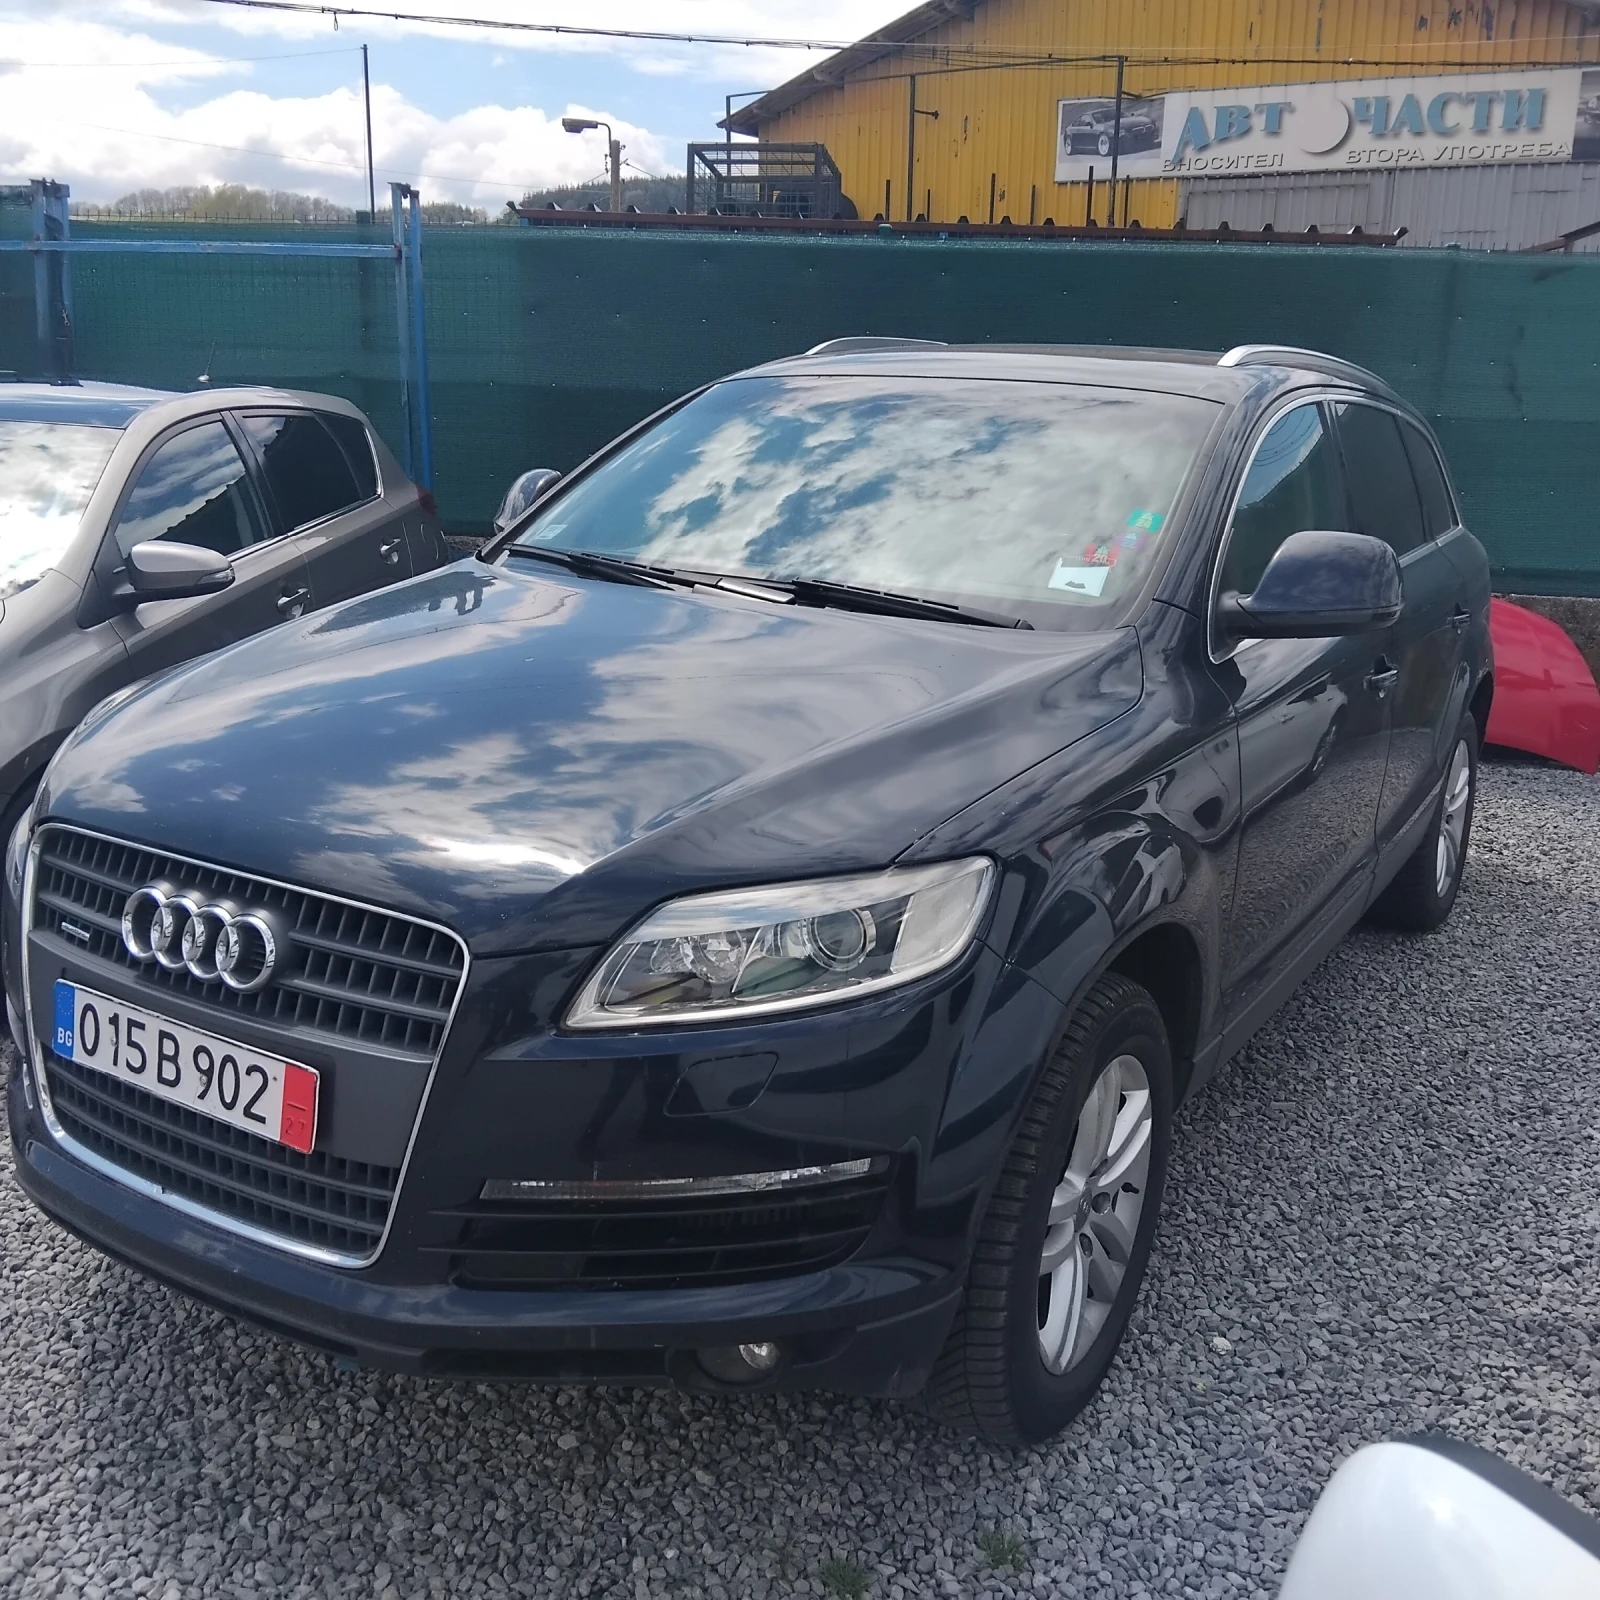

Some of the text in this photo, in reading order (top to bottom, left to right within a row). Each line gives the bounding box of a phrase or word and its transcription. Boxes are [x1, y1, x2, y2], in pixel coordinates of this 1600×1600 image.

[1161, 141, 1572, 173] ВНОСИТЕЛ ВТОРА УПОТРЕБА
[57, 1027, 73, 1047] BG
